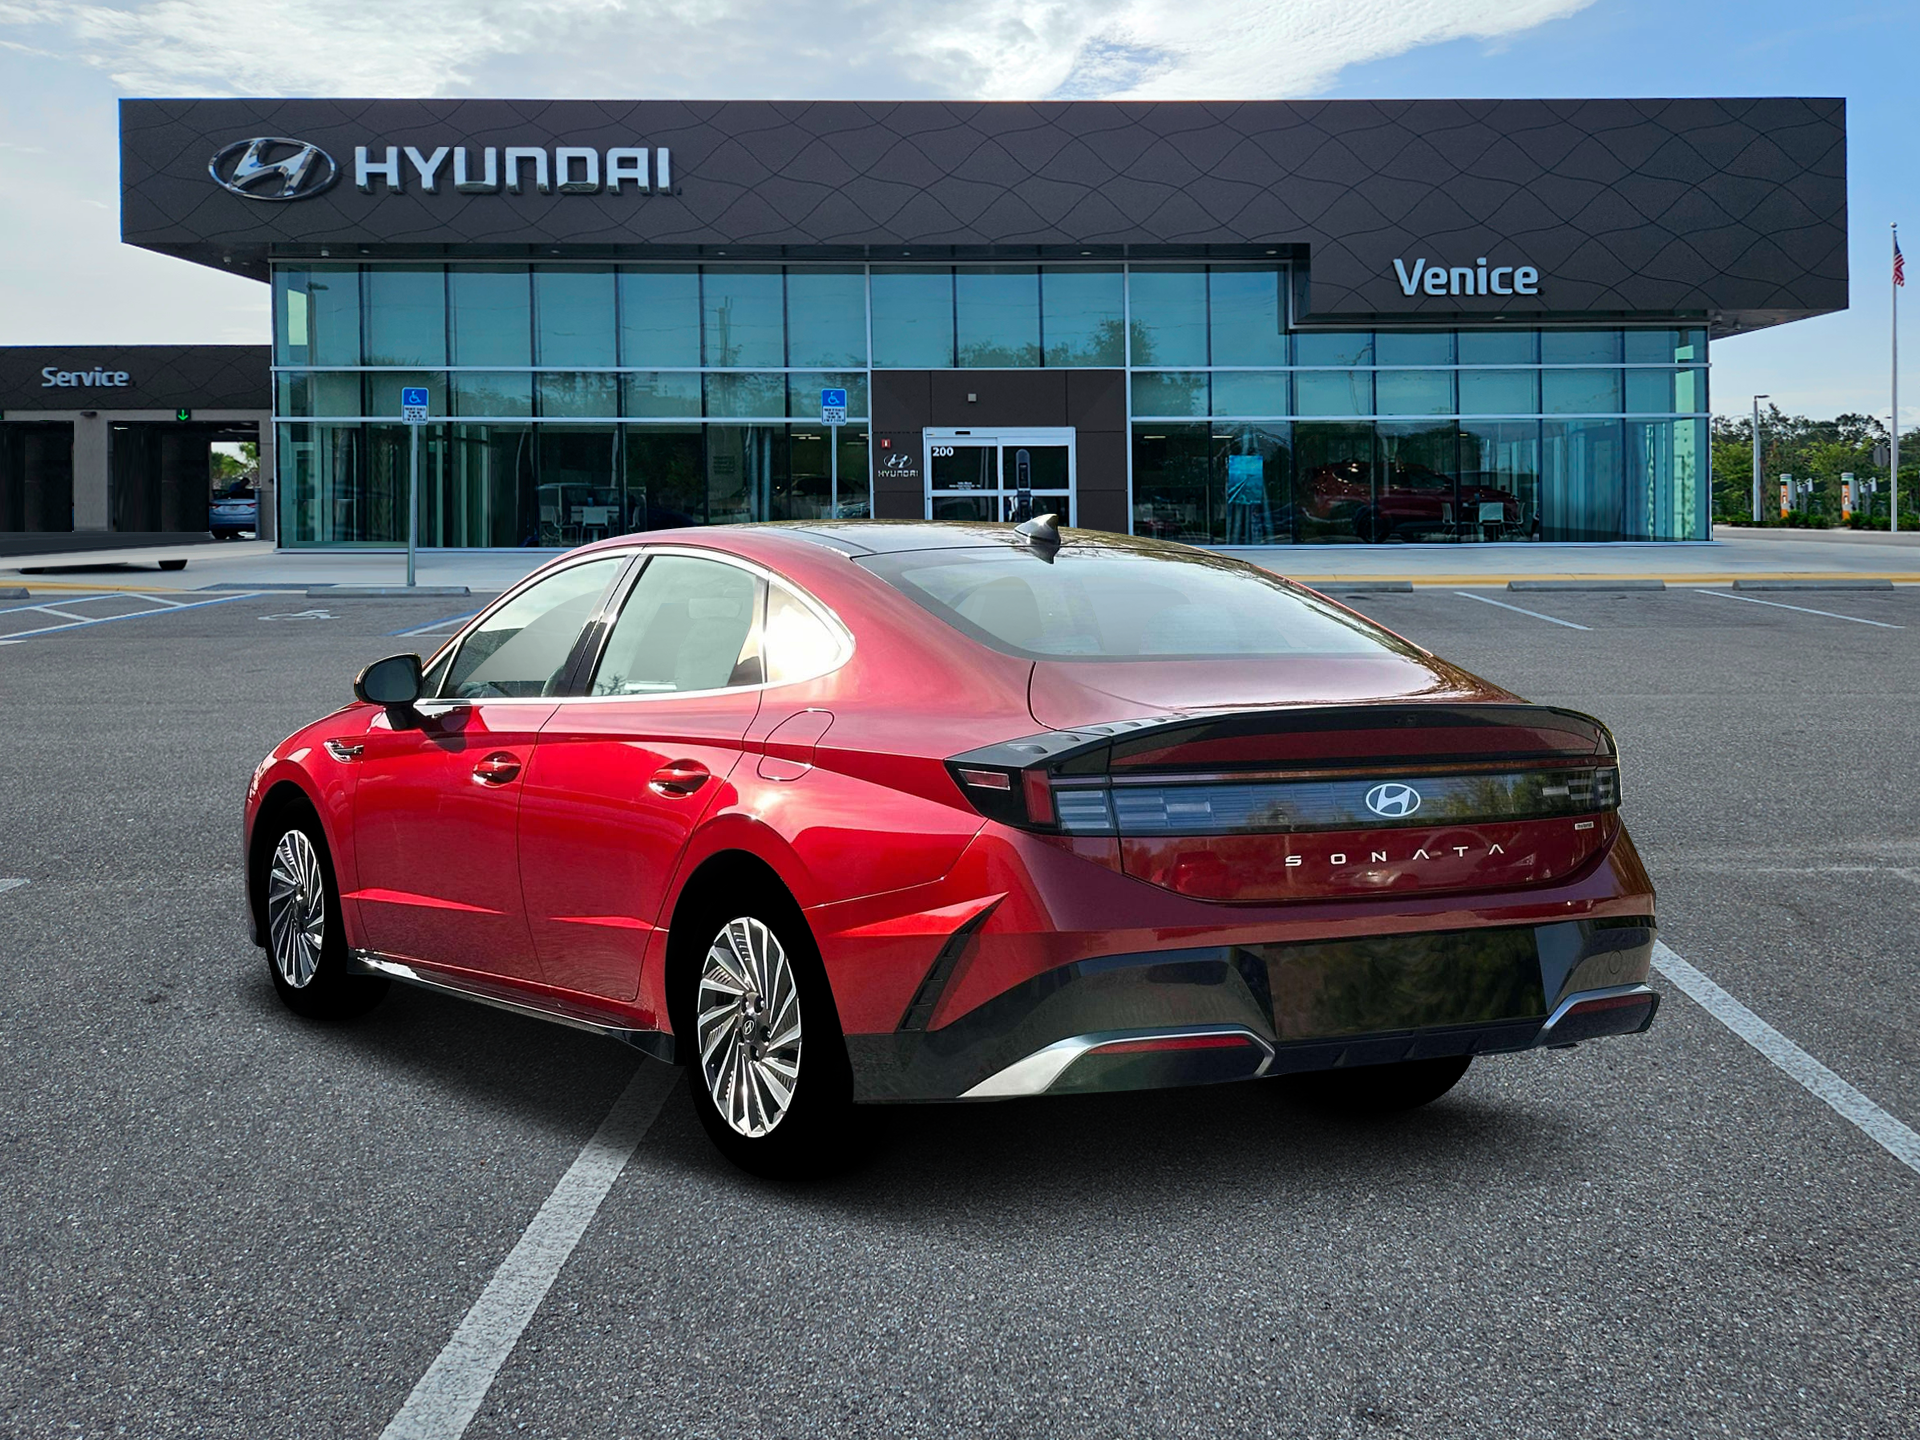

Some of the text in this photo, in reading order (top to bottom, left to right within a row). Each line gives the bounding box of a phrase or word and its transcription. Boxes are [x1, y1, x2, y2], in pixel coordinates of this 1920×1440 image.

[354, 146, 671, 194] HYUNDAI
[1393, 257, 1539, 296] Venice
[41, 366, 130, 388] Service
[932, 446, 954, 457] 200
[877, 469, 919, 478] HYUNDAI
[1284, 843, 1505, 867] SONATA
